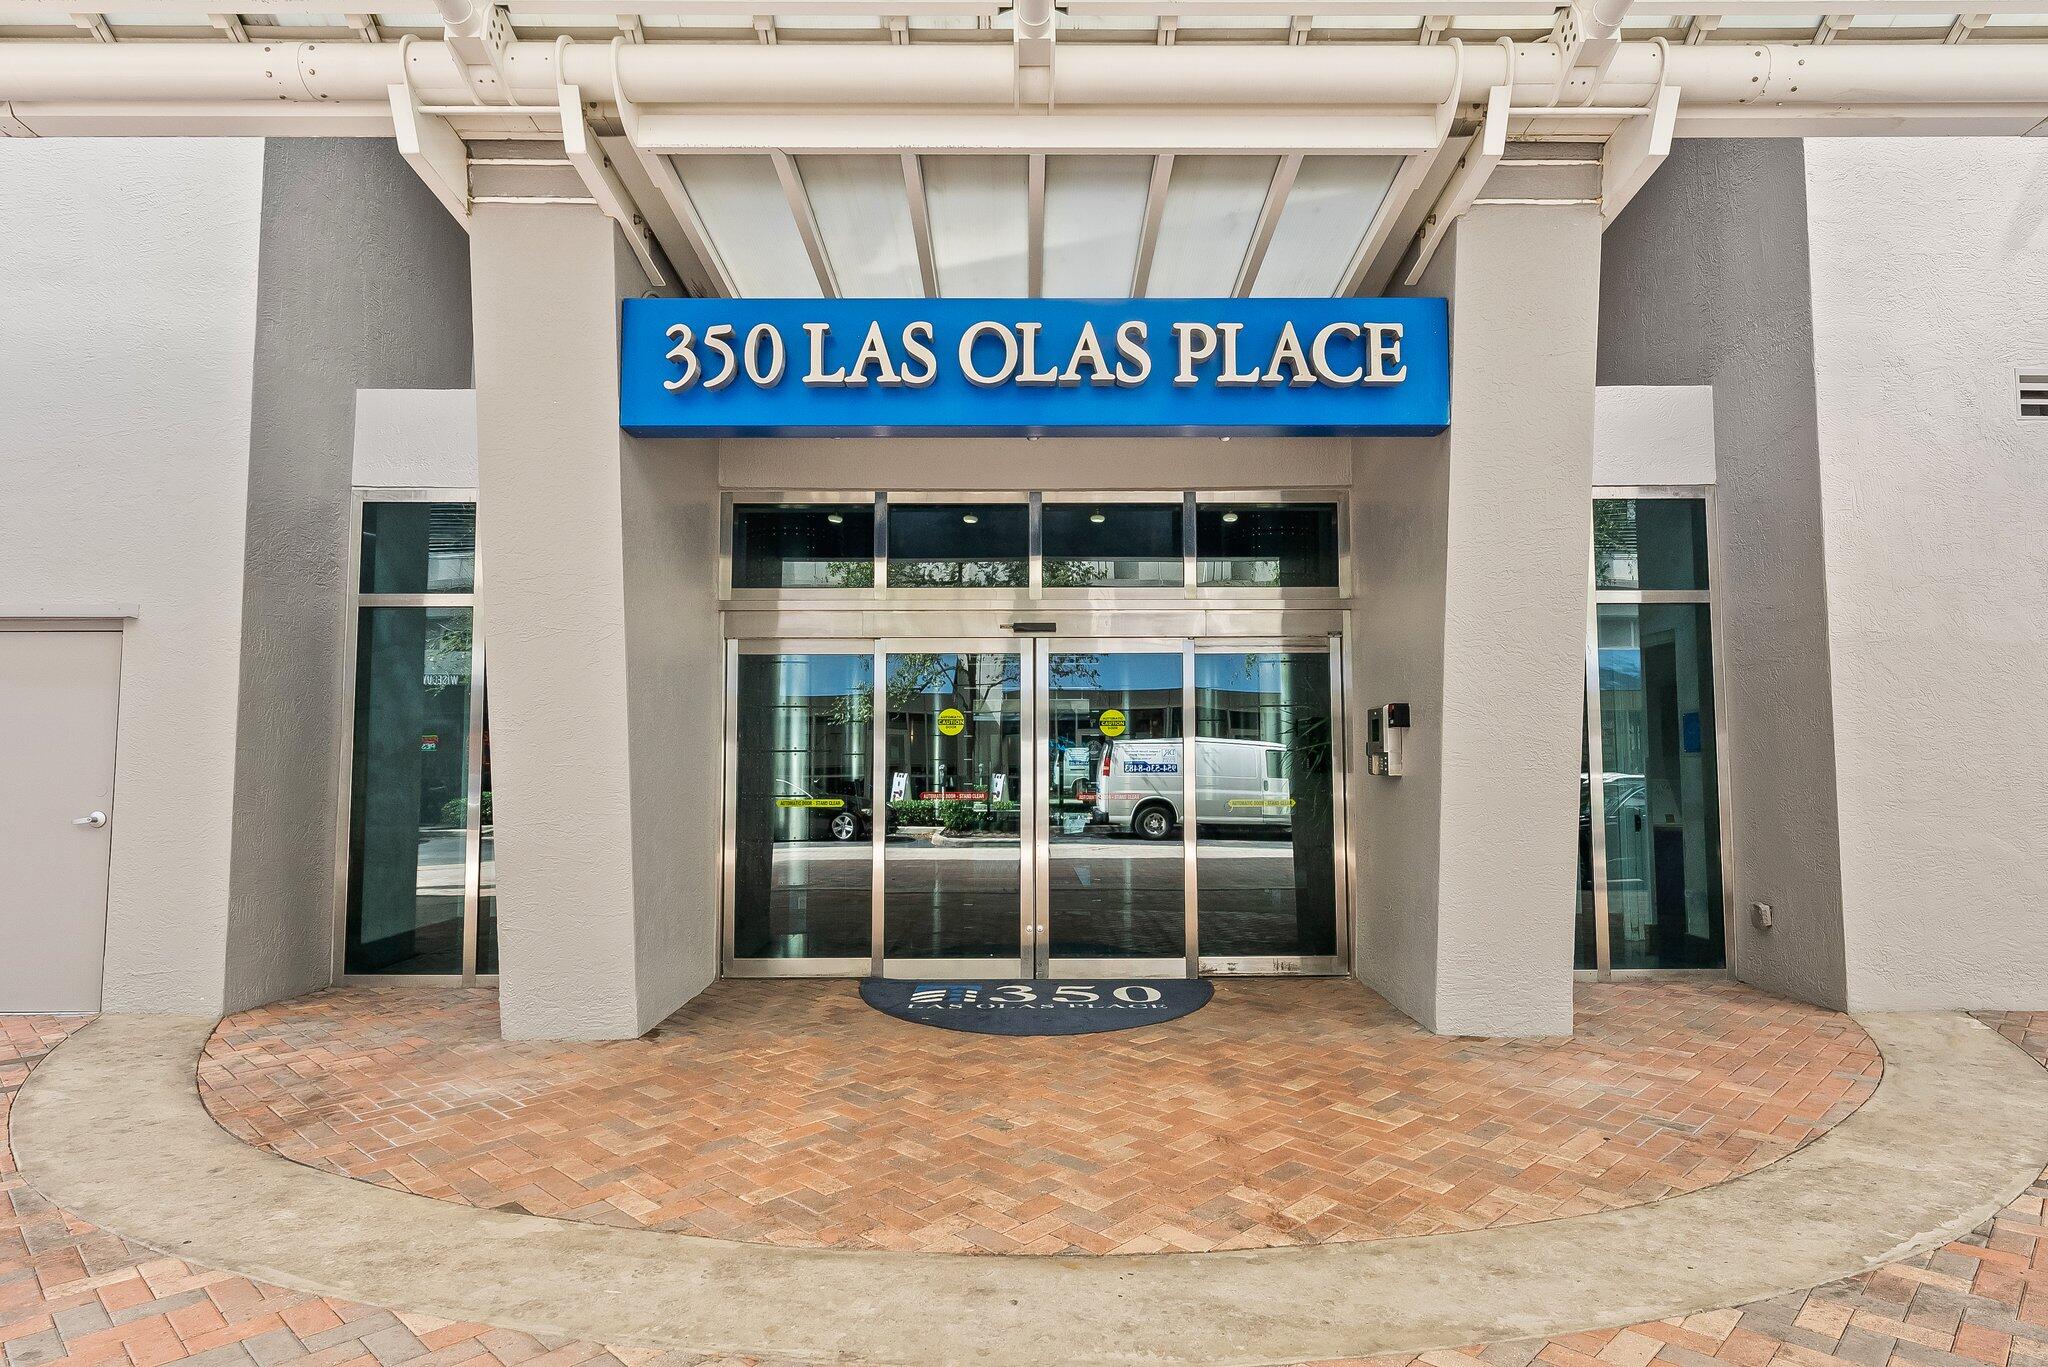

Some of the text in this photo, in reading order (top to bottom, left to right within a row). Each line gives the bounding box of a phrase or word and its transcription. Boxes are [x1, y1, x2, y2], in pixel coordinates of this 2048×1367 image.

[663, 320, 1407, 391] 350 LAS OLAS PLACE
[989, 985, 1161, 1002] 350
